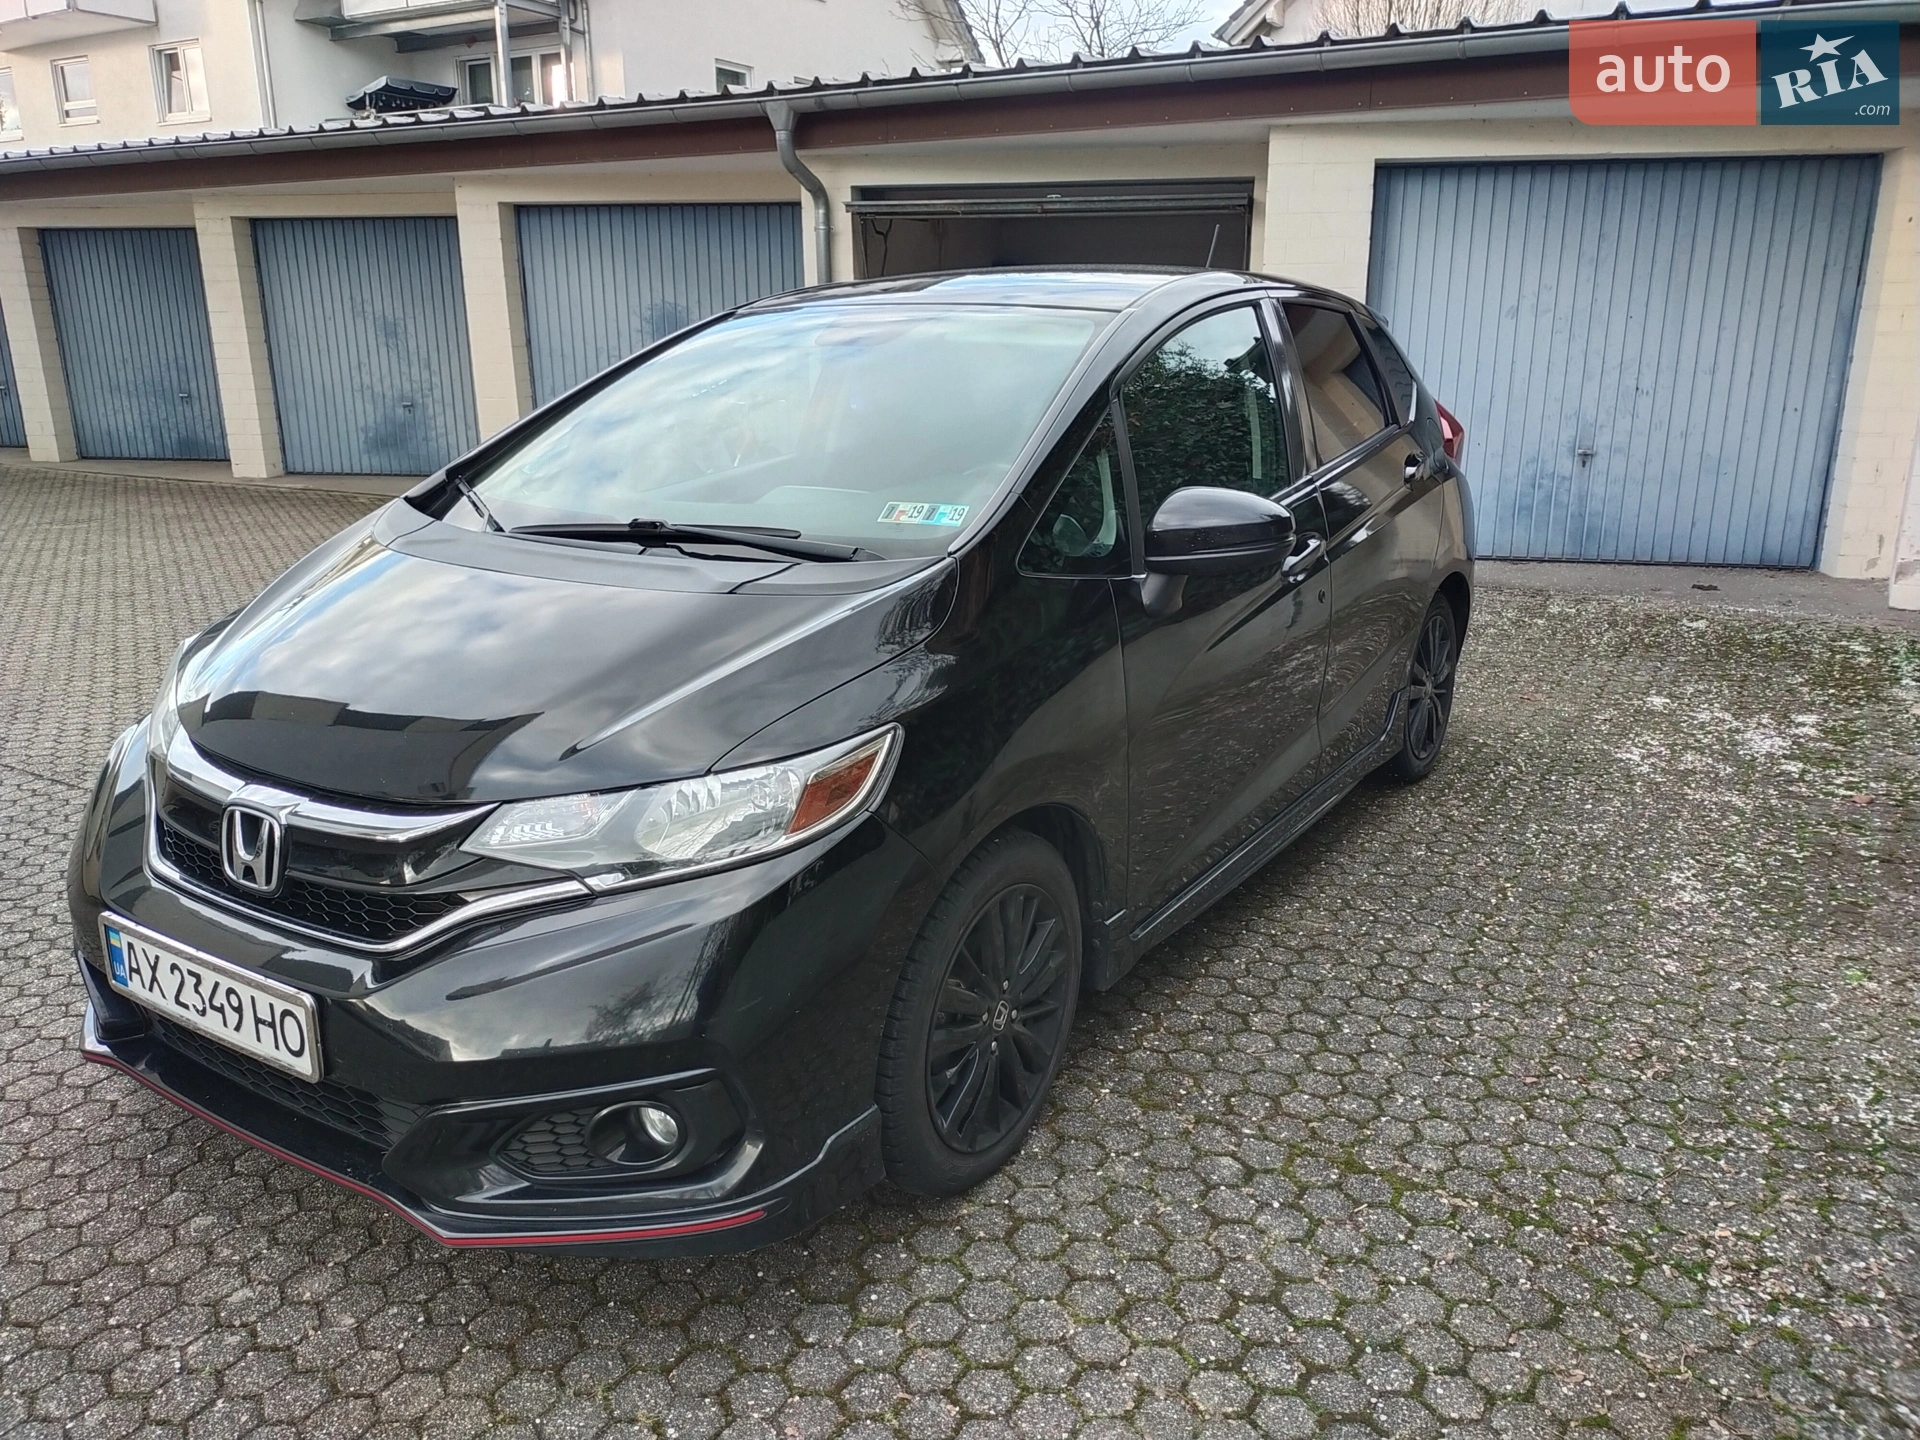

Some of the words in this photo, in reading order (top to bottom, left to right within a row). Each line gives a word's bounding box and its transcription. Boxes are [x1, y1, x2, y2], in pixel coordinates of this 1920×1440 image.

[907, 505, 924, 519] 19
[948, 507, 965, 521] 19
[113, 960, 126, 979] UA
[126, 941, 167, 1000] AX
[169, 962, 244, 1033] 2349
[250, 994, 305, 1058] HO
